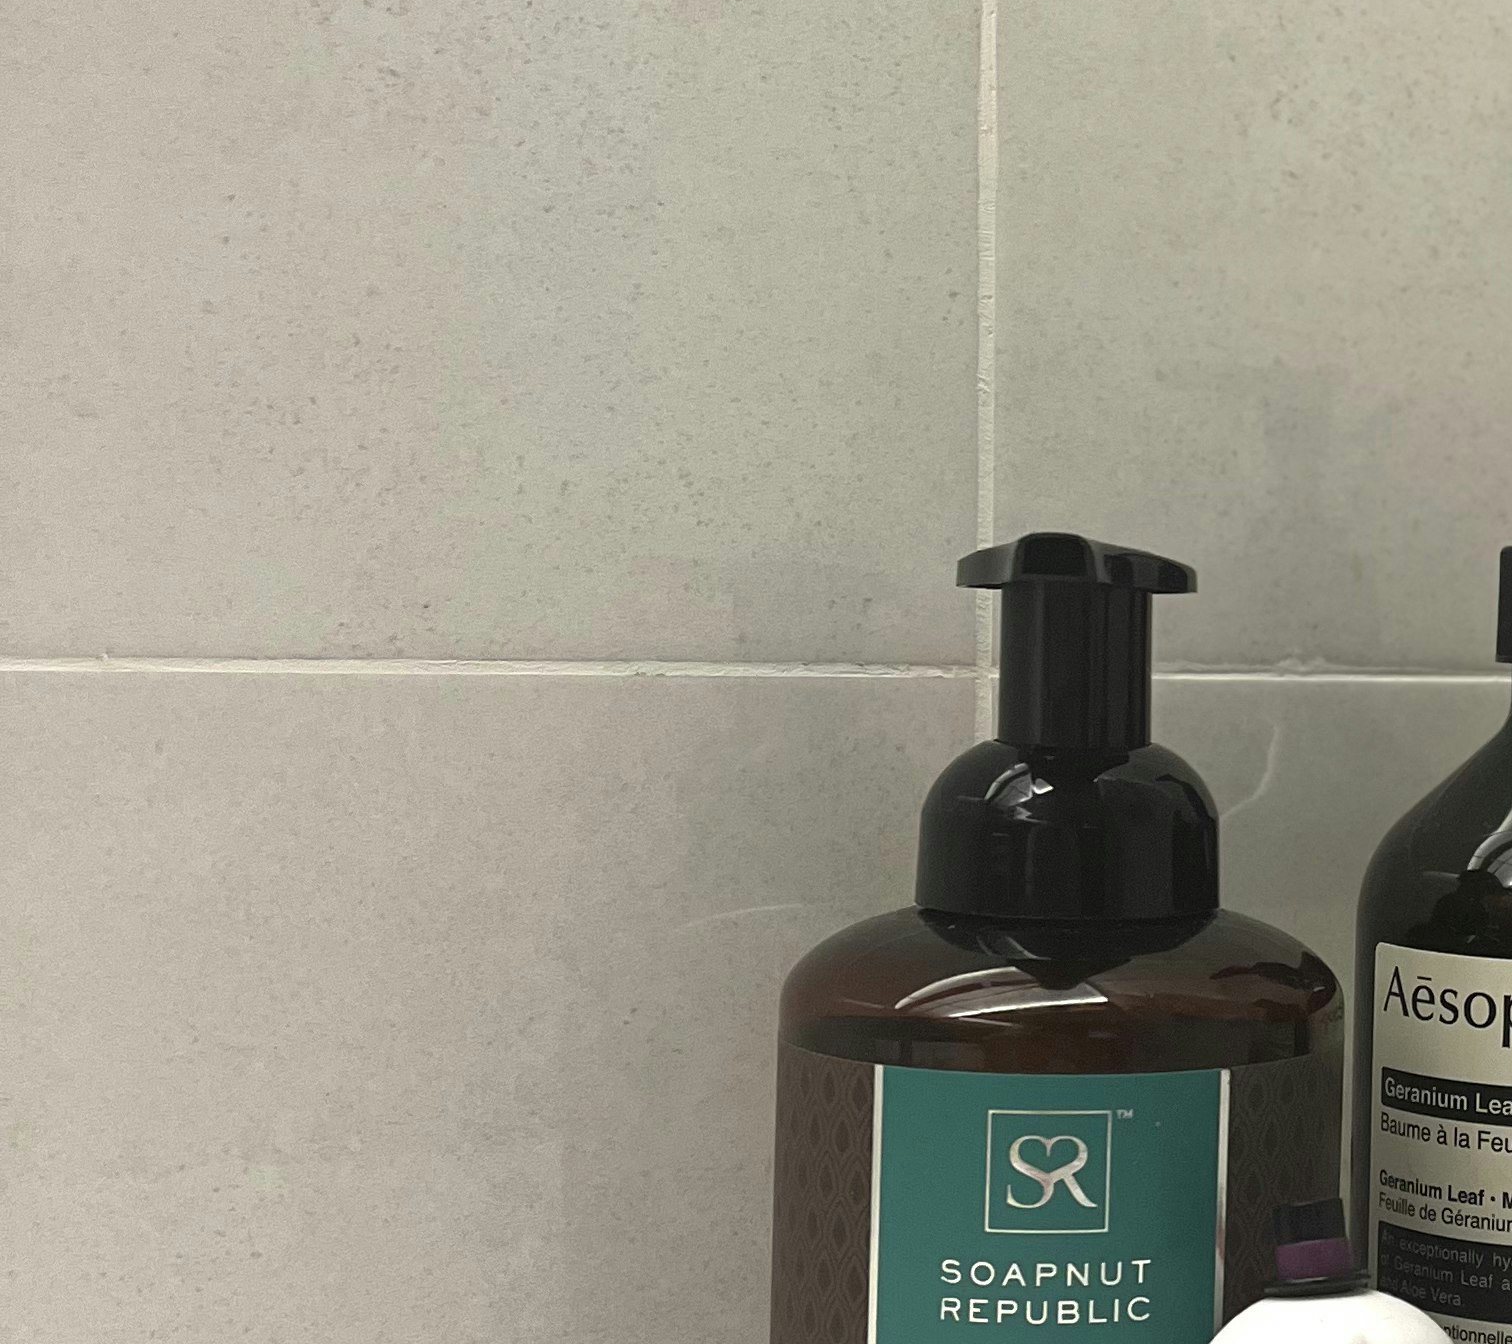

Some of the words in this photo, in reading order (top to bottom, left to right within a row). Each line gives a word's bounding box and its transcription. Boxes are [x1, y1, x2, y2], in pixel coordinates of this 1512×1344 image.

[1384, 1076, 1468, 1112] Geranium
[1380, 1112, 1431, 1142] Baume
[1436, 1124, 1448, 1146] à
[1453, 1127, 1470, 1149] la
[1379, 1169, 1442, 1200] Geranium
[1447, 1185, 1485, 1206] Leaf
[1378, 1192, 1416, 1218] Feuille
[1419, 1204, 1437, 1222] de
[1399, 1237, 1484, 1269] exceptionally
[940, 1258, 1152, 1287] SOAPNUT
[1393, 1255, 1454, 1283] Geranium
[1460, 1269, 1494, 1289] Leaf
[1399, 1279, 1427, 1300] Aloe
[939, 1296, 1151, 1325] REPUBLIC
